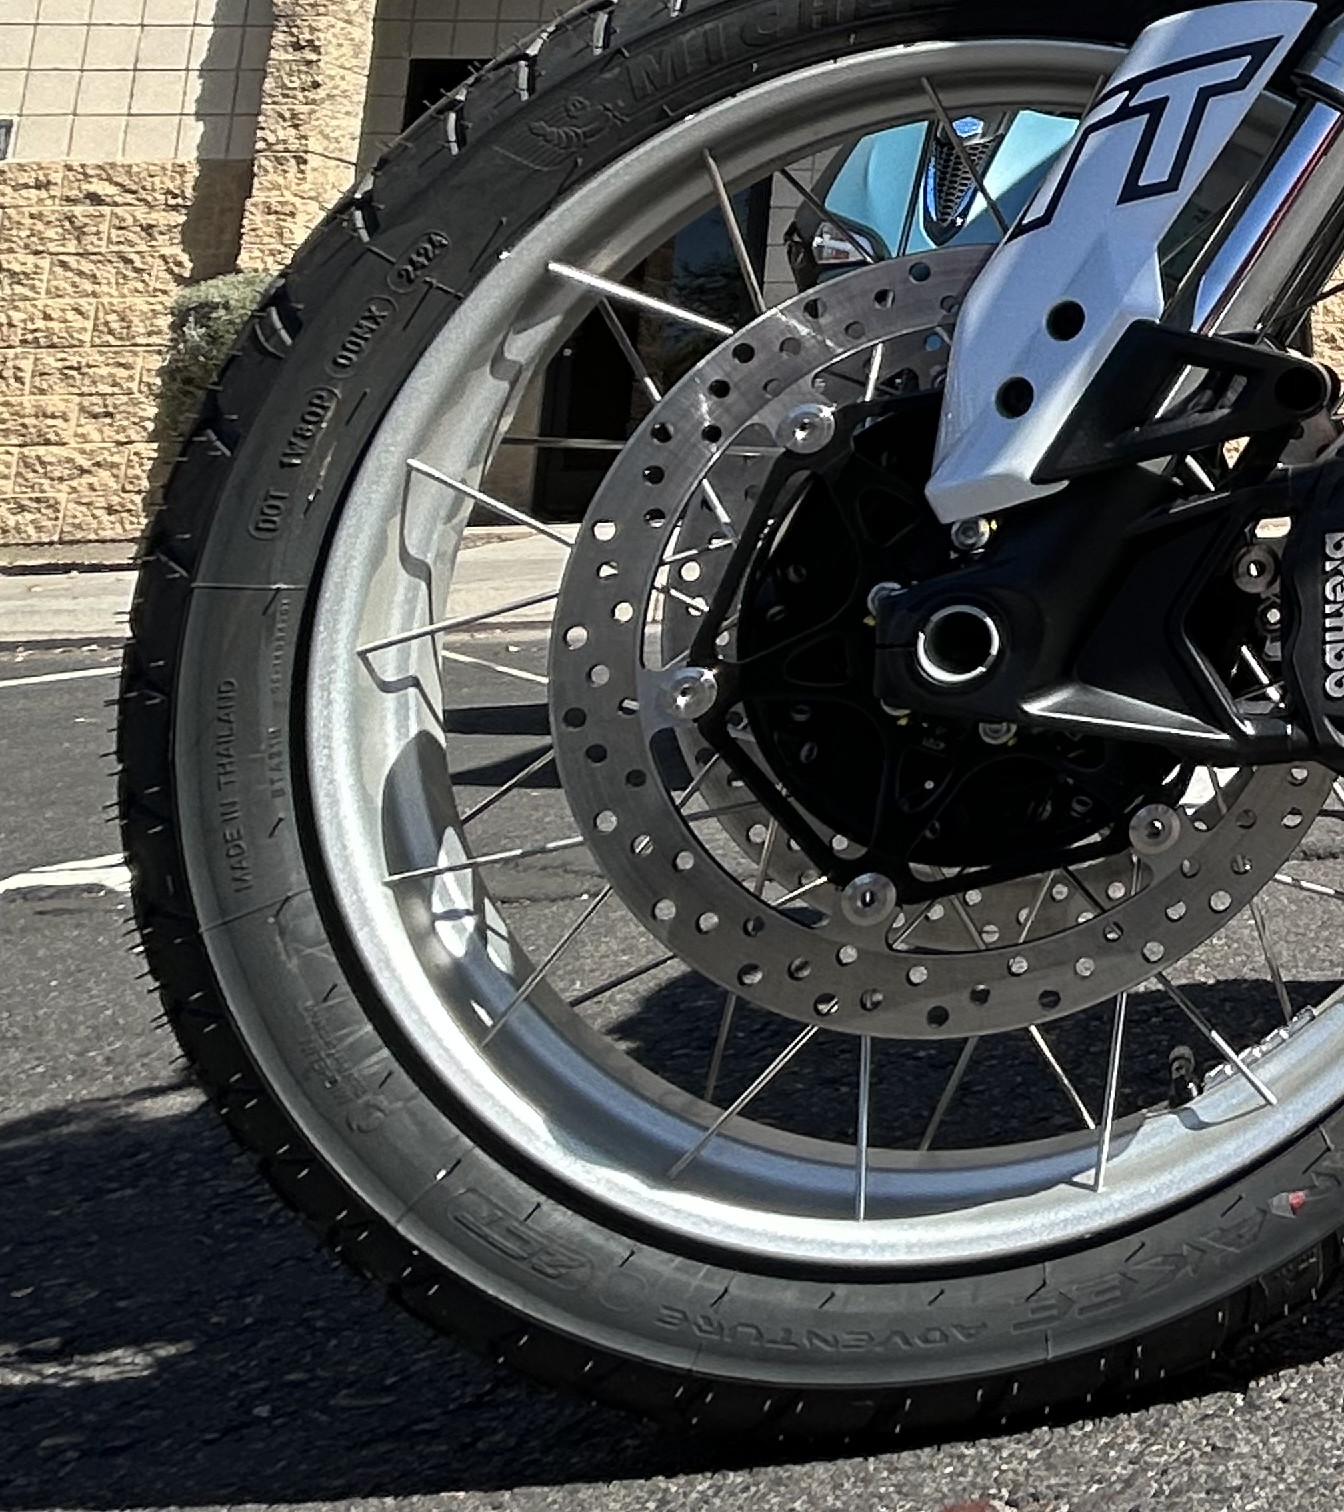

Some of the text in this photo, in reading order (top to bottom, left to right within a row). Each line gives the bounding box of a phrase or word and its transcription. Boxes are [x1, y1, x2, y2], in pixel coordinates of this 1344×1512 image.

[397, 231, 450, 285] 2424
[255, 490, 291, 533] DOT
[214, 677, 254, 895] MADE IN THAILAND
[652, 1302, 990, 1353] ADVENTURE
